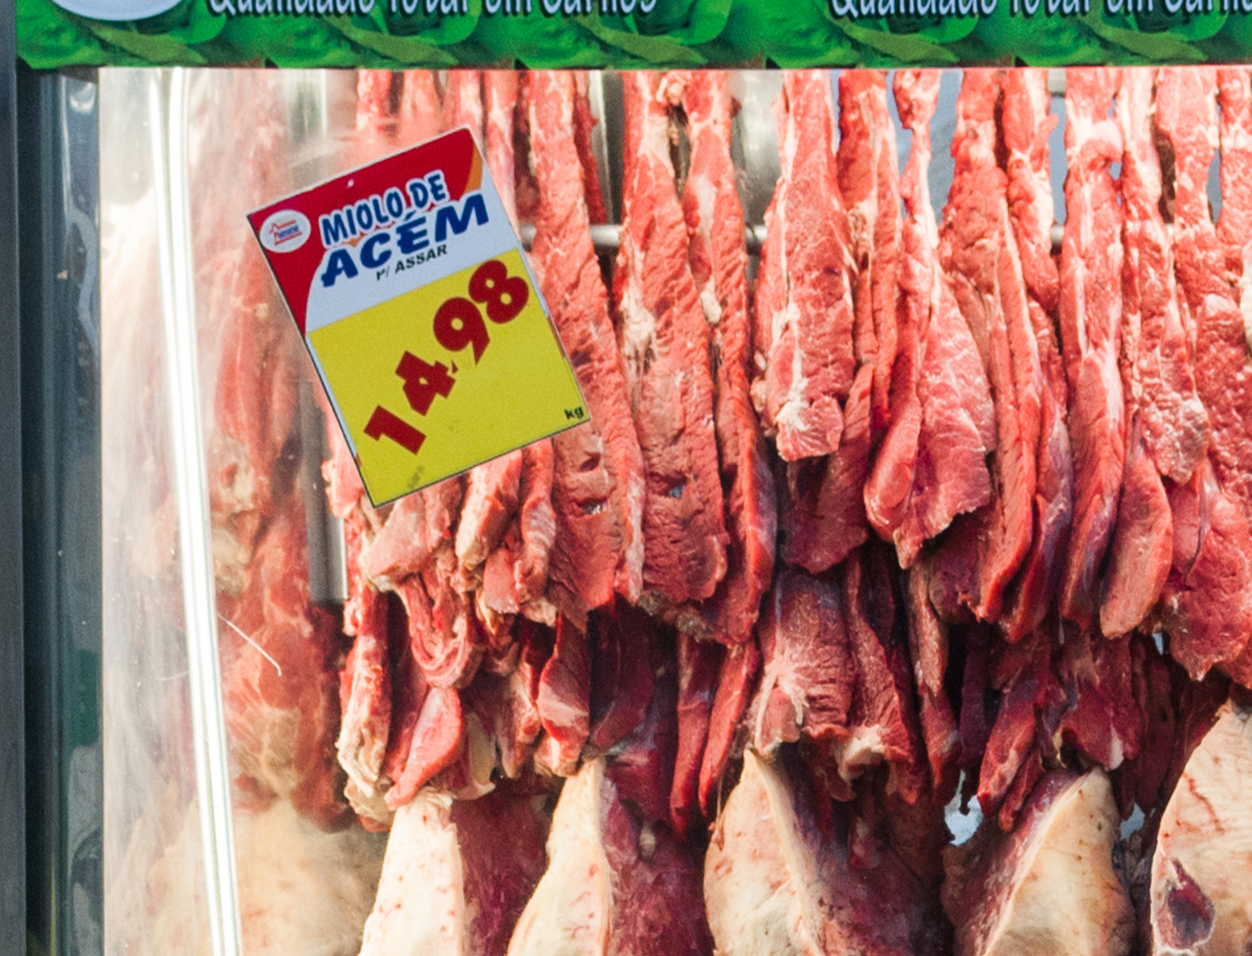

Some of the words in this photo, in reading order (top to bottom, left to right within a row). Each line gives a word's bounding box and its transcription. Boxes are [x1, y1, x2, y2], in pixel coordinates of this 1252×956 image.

[322, 190, 402, 246] MIOLO
[409, 174, 447, 207] DE
[321, 193, 489, 287] ACÉM
[395, 244, 447, 273] ASSAR
[564, 406, 584, 421] kg
